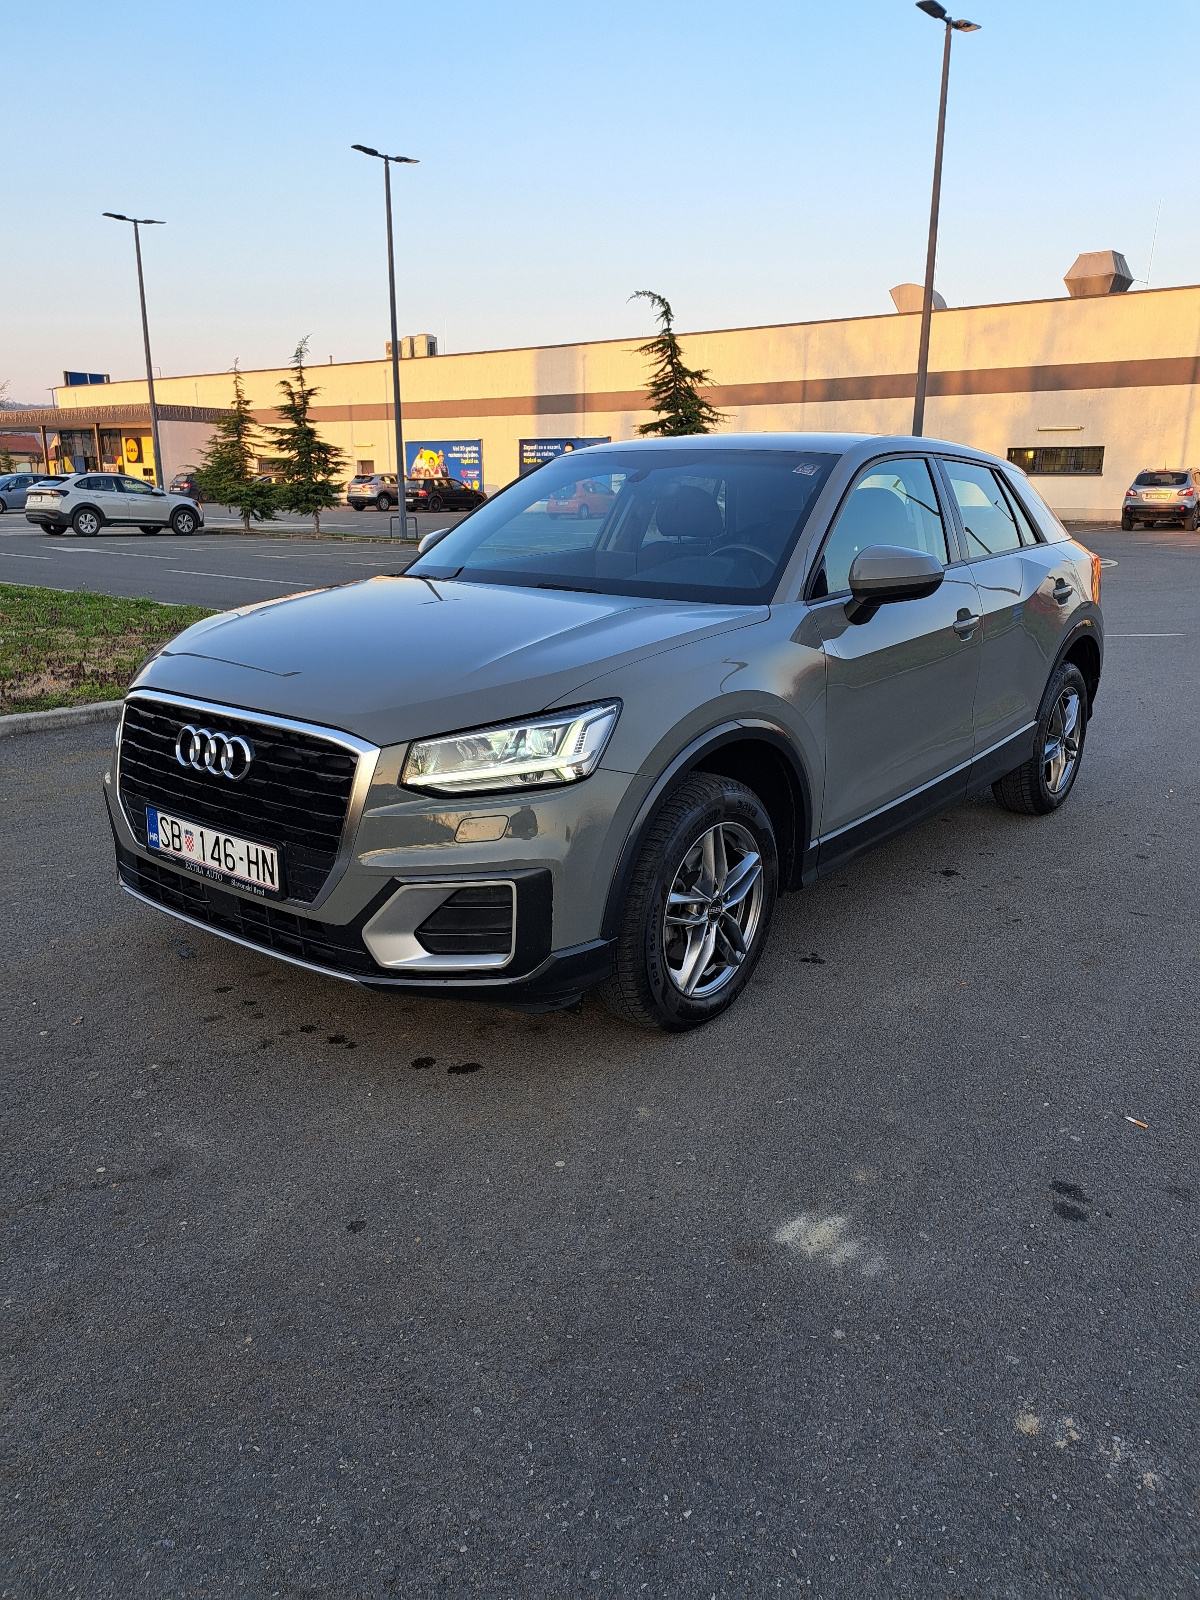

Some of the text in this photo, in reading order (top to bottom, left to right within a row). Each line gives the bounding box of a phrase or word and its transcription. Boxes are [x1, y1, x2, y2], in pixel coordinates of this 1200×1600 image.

[150, 832, 159, 843] HR
[160, 816, 275, 886] SB 146-HN
[206, 869, 223, 881] AUTO
